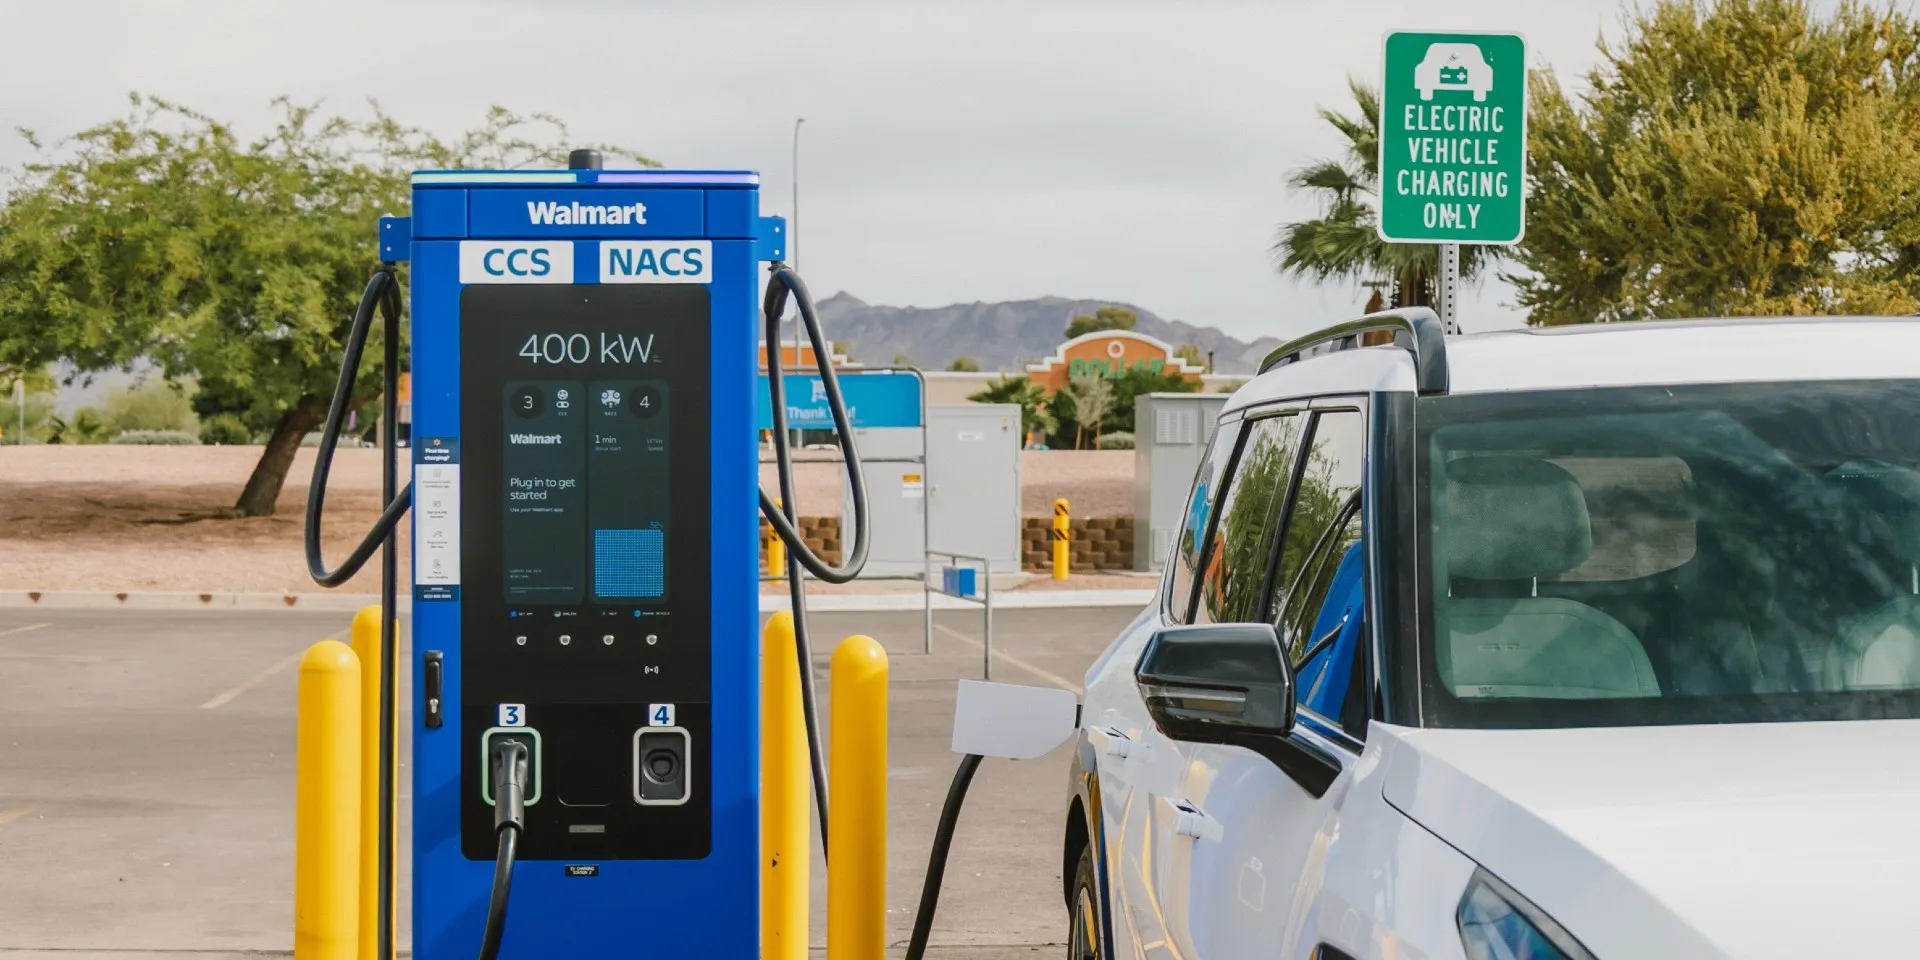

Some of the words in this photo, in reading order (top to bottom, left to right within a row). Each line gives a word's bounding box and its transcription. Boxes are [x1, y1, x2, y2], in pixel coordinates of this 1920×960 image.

[1404, 104, 1504, 133] ELECTRIC
[1408, 137, 1499, 165] VEHICLE
[1397, 169, 1508, 198] CHARGING
[527, 201, 647, 225] Walmart
[1423, 202, 1481, 229] ONLY
[483, 248, 551, 276] CCS
[608, 248, 703, 276] NACS
[519, 333, 590, 364] 400
[600, 332, 654, 363] kW
[523, 395, 533, 409] 3
[639, 395, 651, 409] 4
[787, 405, 825, 419] Thank
[510, 433, 562, 445] Walmart
[595, 434, 601, 444] 1
[602, 435, 617, 444] min
[510, 477, 533, 490] Plug
[534, 477, 544, 487] in
[545, 478, 557, 487] to
[558, 478, 576, 490] get
[510, 490, 547, 500] started
[505, 706, 519, 724] 3
[654, 706, 670, 724] 4
